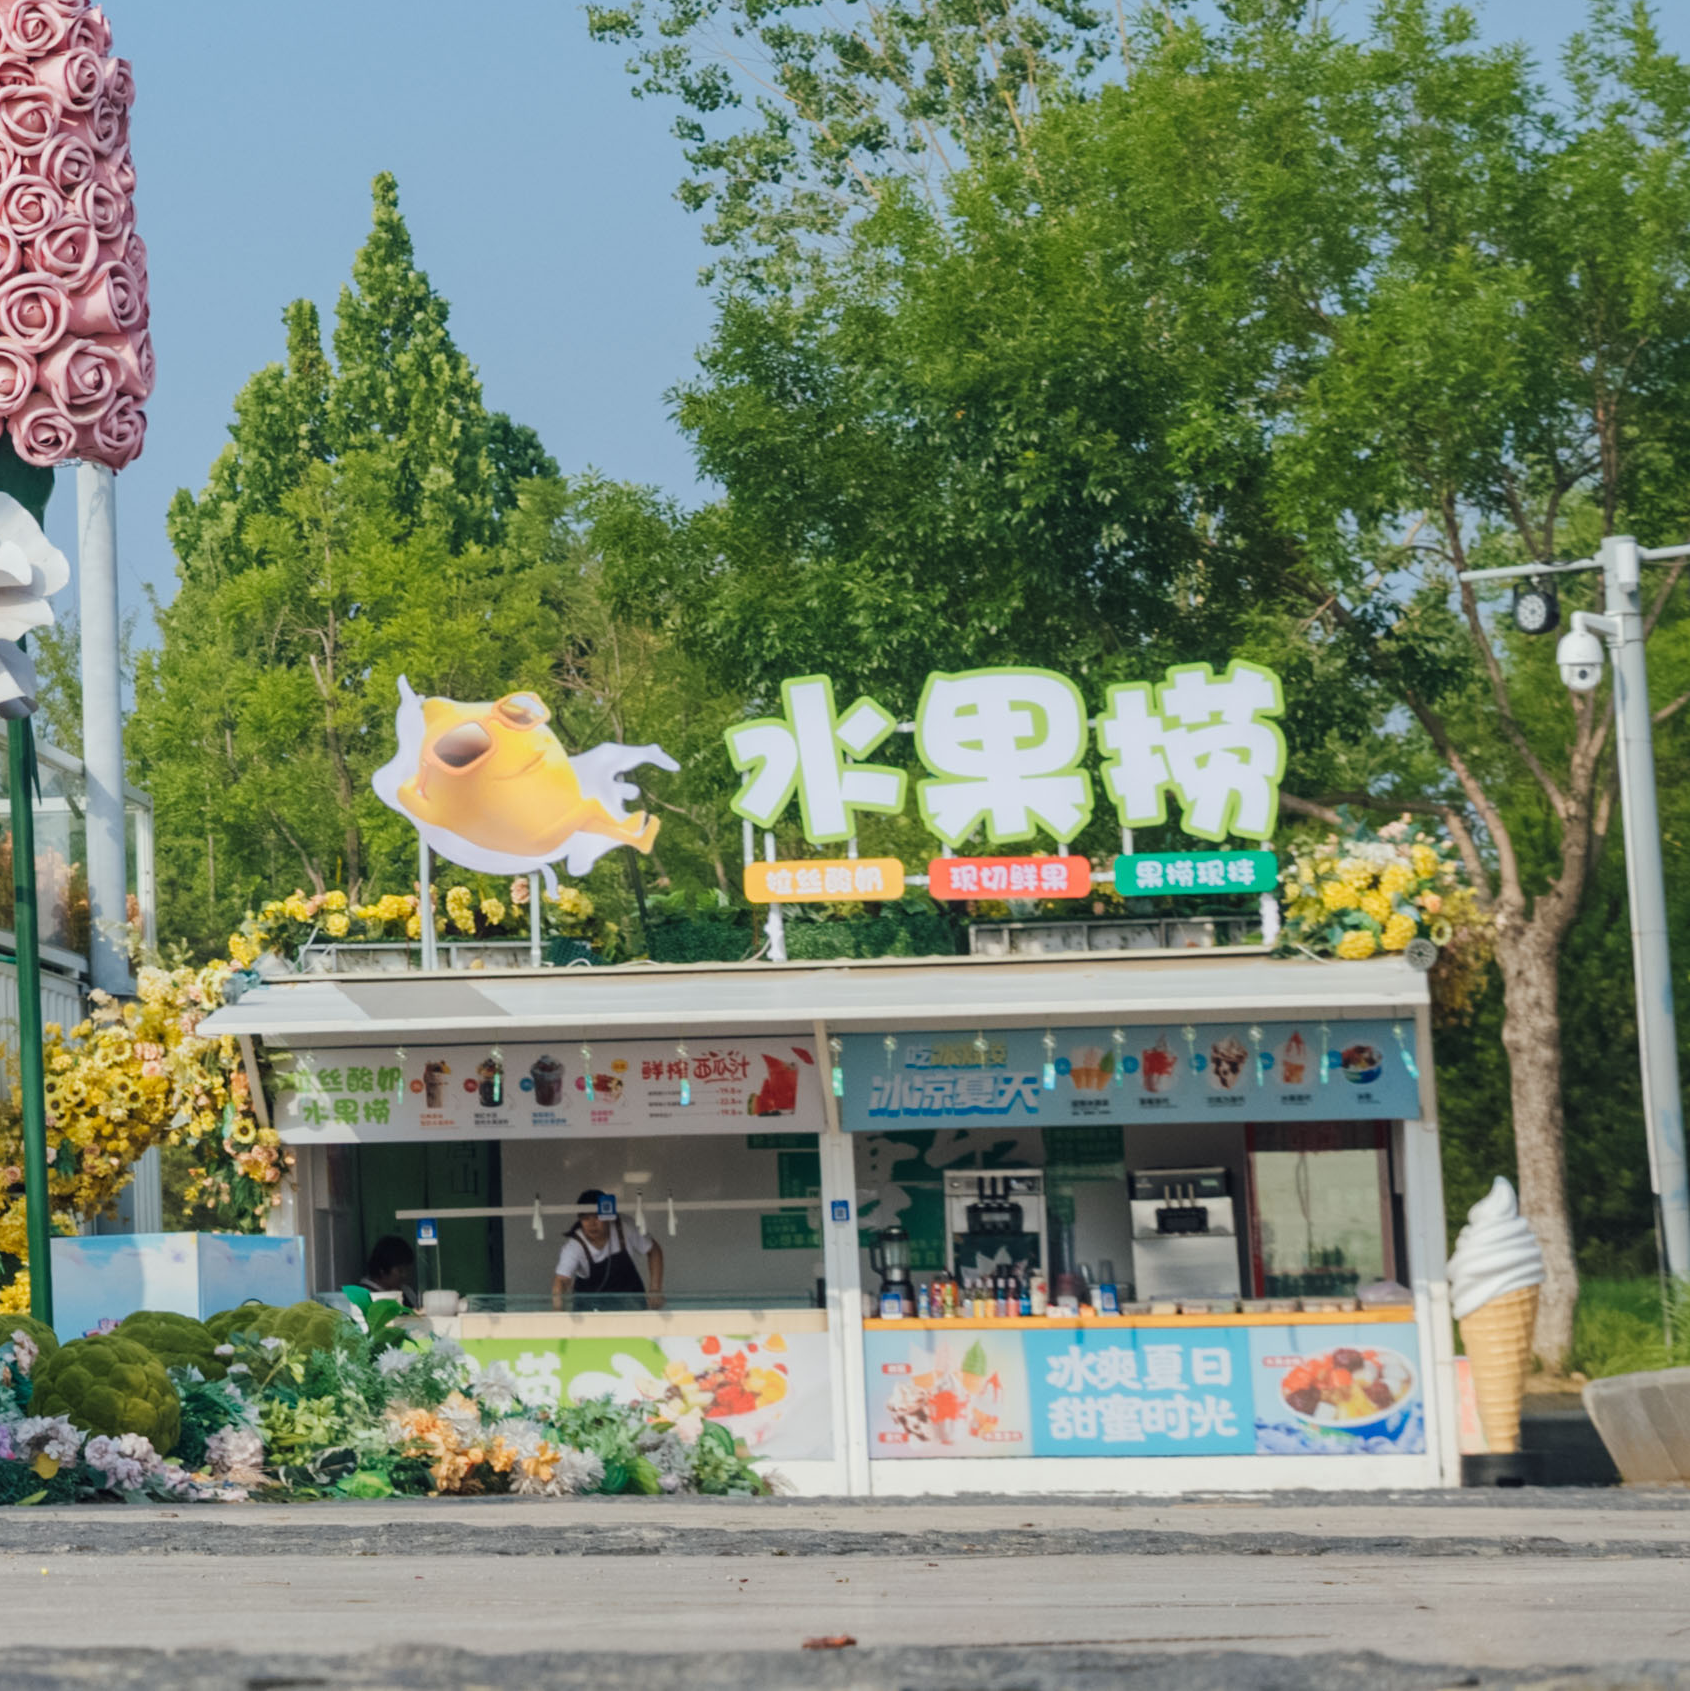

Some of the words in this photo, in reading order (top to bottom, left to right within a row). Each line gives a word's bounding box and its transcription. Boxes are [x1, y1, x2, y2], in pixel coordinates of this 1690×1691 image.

[729, 660, 1286, 846] 水果捞
[765, 865, 884, 895] 拉丝酸奶
[949, 863, 1069, 894] 现切鲜果
[1134, 858, 1257, 890] 果捞现拌
[302, 1098, 391, 1125] 水果捞
[869, 1071, 1041, 1116] 冰凉夏天
[1046, 1343, 1232, 1393] 冰爽夏日
[1046, 1393, 1240, 1442] 甜蜜时光
